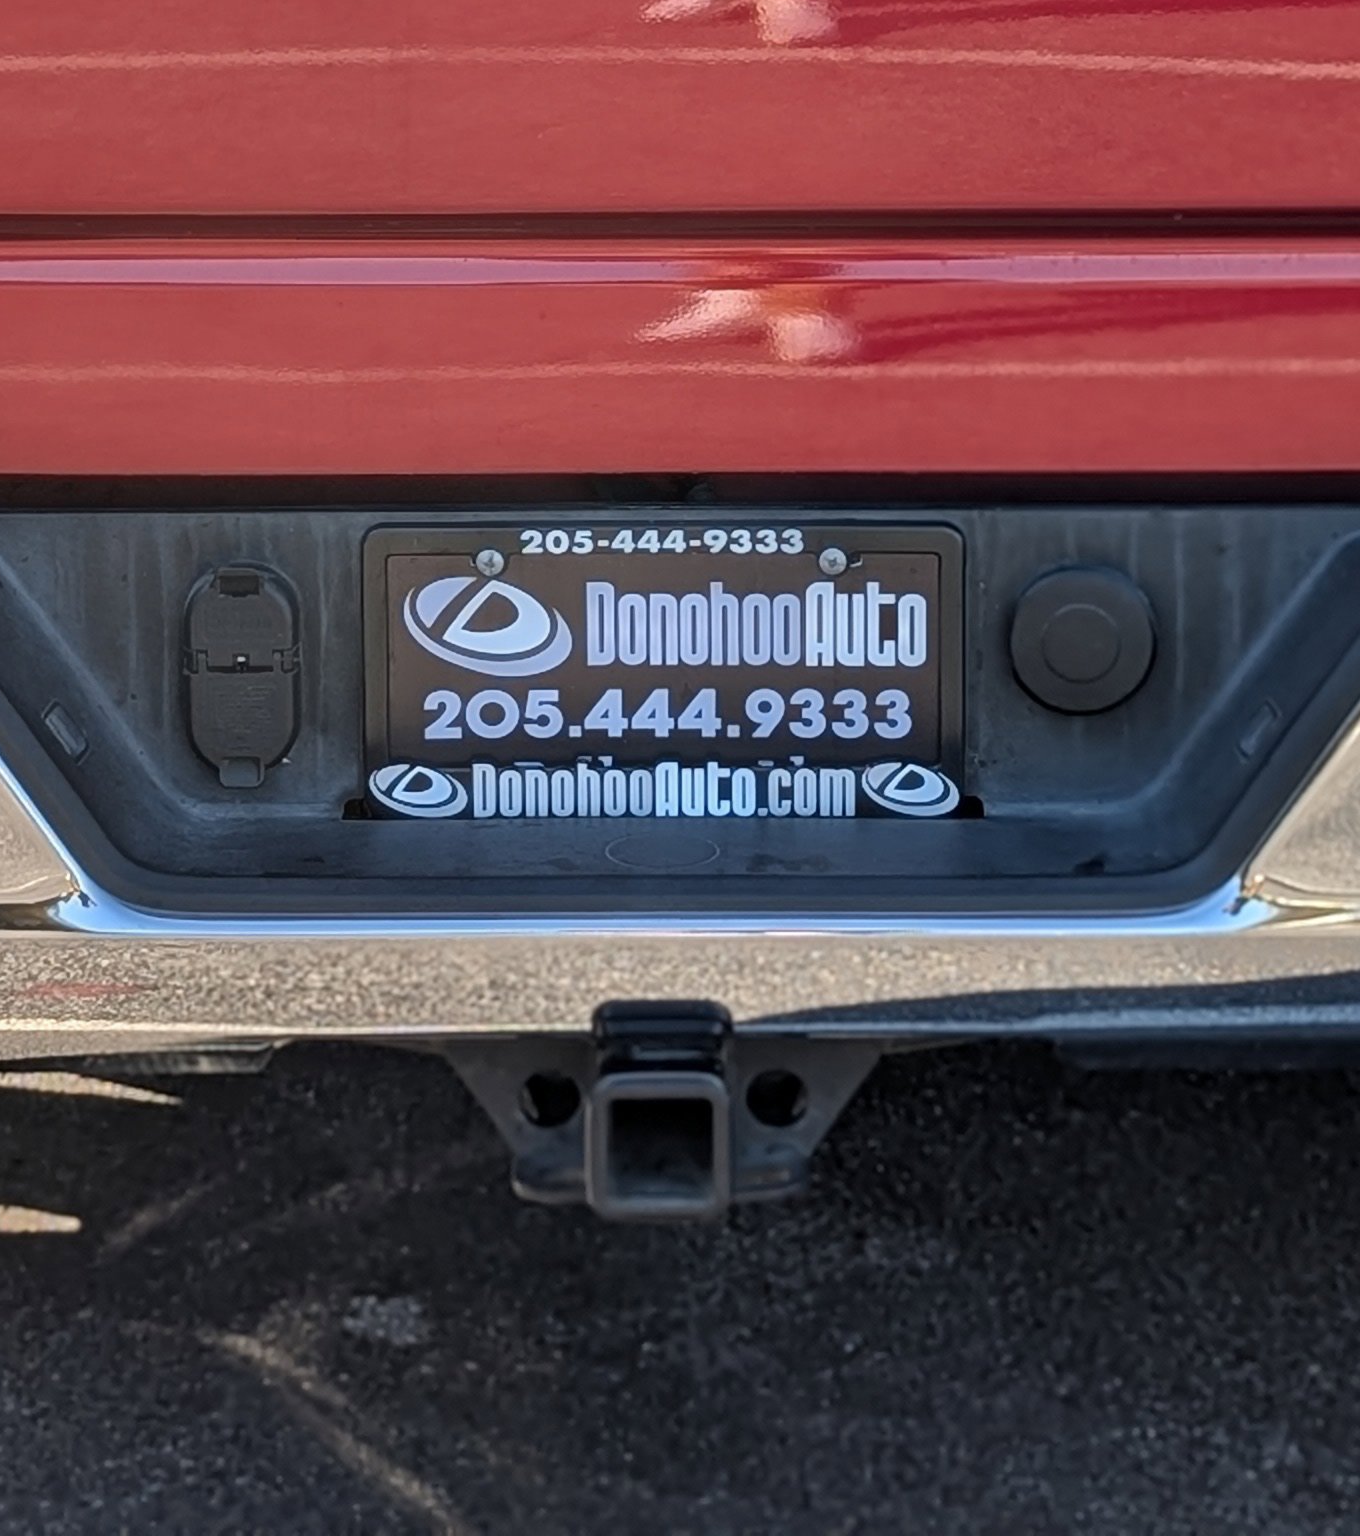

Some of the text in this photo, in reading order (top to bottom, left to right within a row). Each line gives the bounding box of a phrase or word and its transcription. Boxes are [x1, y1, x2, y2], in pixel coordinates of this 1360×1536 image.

[520, 529, 804, 554] 205-444-9333
[586, 581, 927, 667] DonohooAuto
[423, 688, 913, 740] 205.444.9333
[472, 761, 856, 818] DonohooAuto.com
